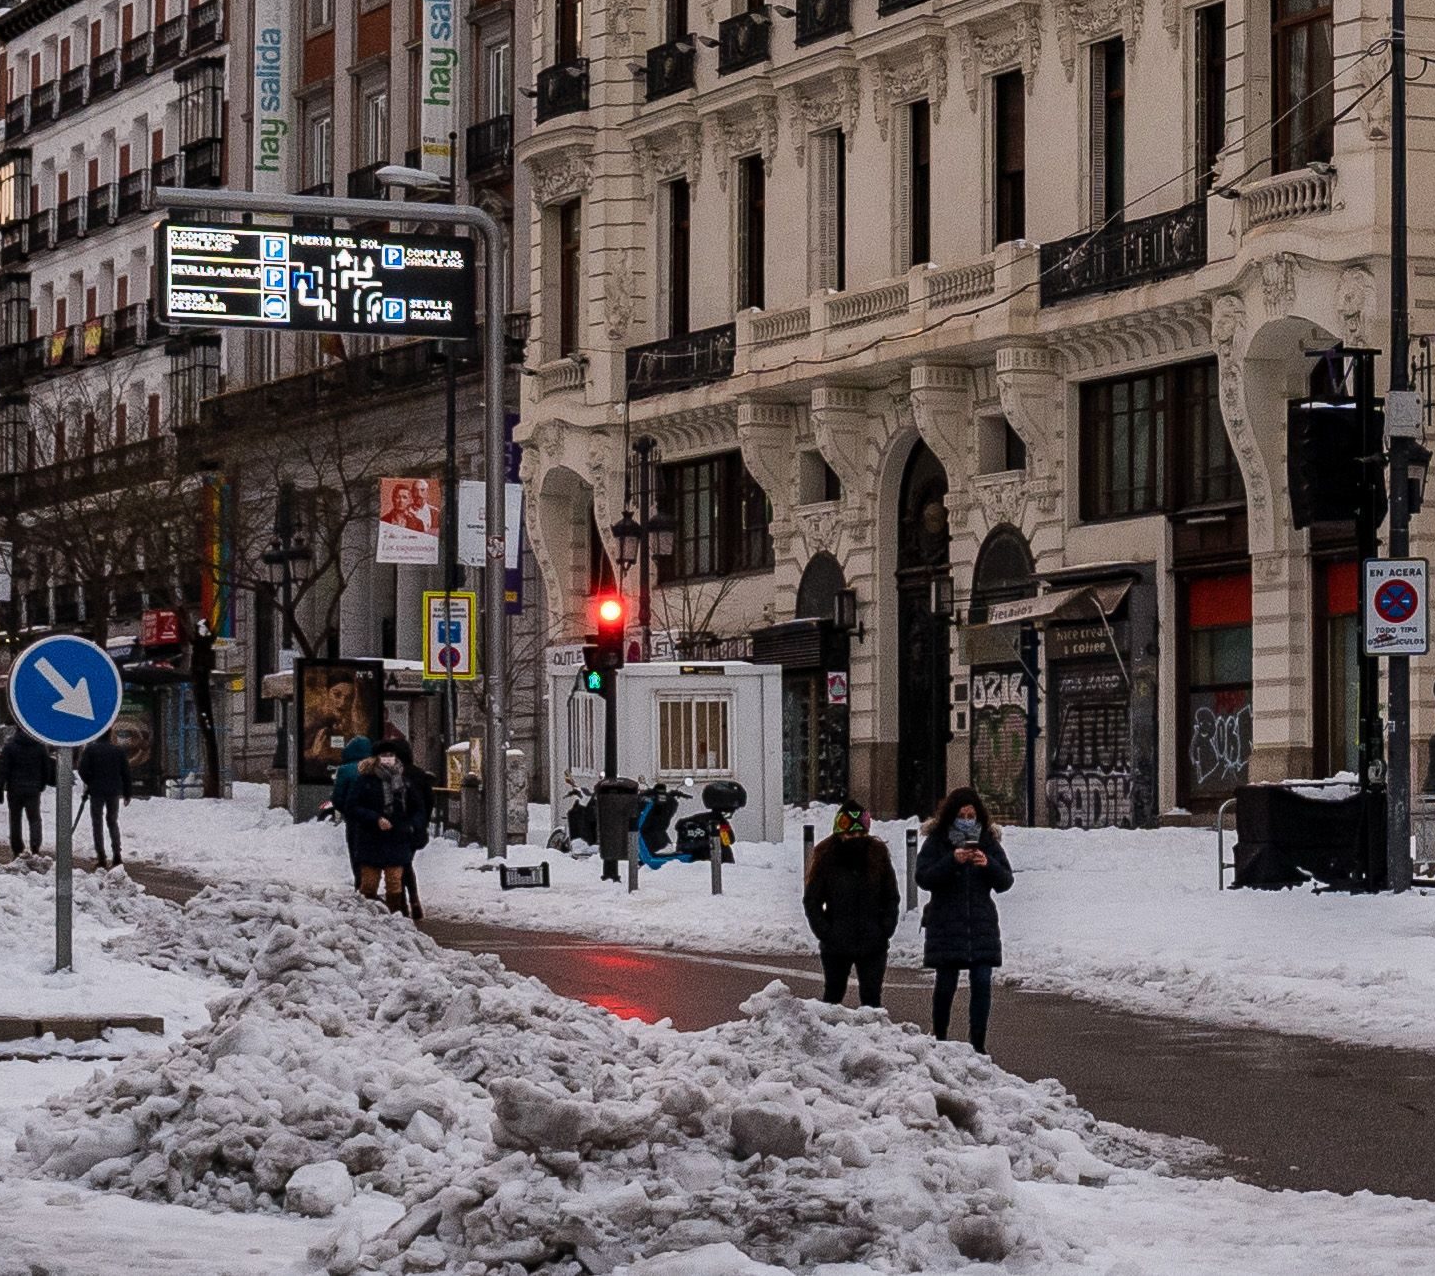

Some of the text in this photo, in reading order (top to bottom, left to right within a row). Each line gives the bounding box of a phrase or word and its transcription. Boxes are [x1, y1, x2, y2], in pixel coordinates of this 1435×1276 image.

[255, 28, 283, 113] salida
[422, 46, 459, 108] hay
[255, 118, 288, 173] hay
[292, 234, 381, 249] PUERTA DEL SOL
[406, 248, 461, 260] COMPLEJO
[405, 257, 464, 269] CANALEJAS
[409, 299, 452, 310] SEVILLA
[410, 309, 452, 321] ALCALÁ
[1370, 567, 1423, 578] EN ACERA
[1375, 626, 1397, 634] TODO
[553, 650, 583, 666] OUTLE
